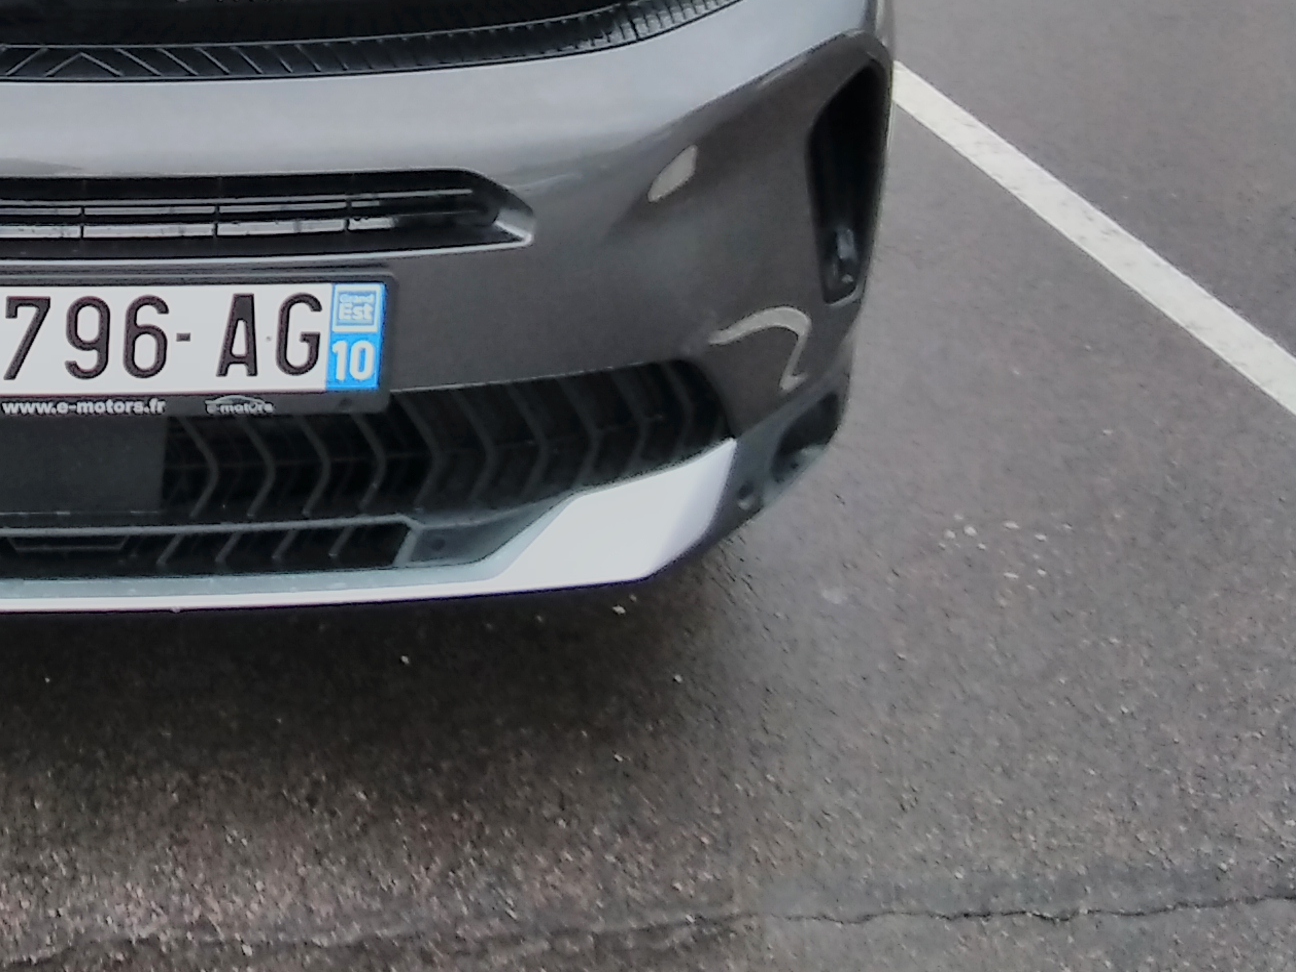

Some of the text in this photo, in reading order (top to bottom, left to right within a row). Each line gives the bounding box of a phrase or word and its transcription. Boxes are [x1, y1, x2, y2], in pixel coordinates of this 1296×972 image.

[338, 302, 373, 321] Est
[331, 339, 376, 381] 10
[1, 398, 167, 416] www.e-motors.fr
